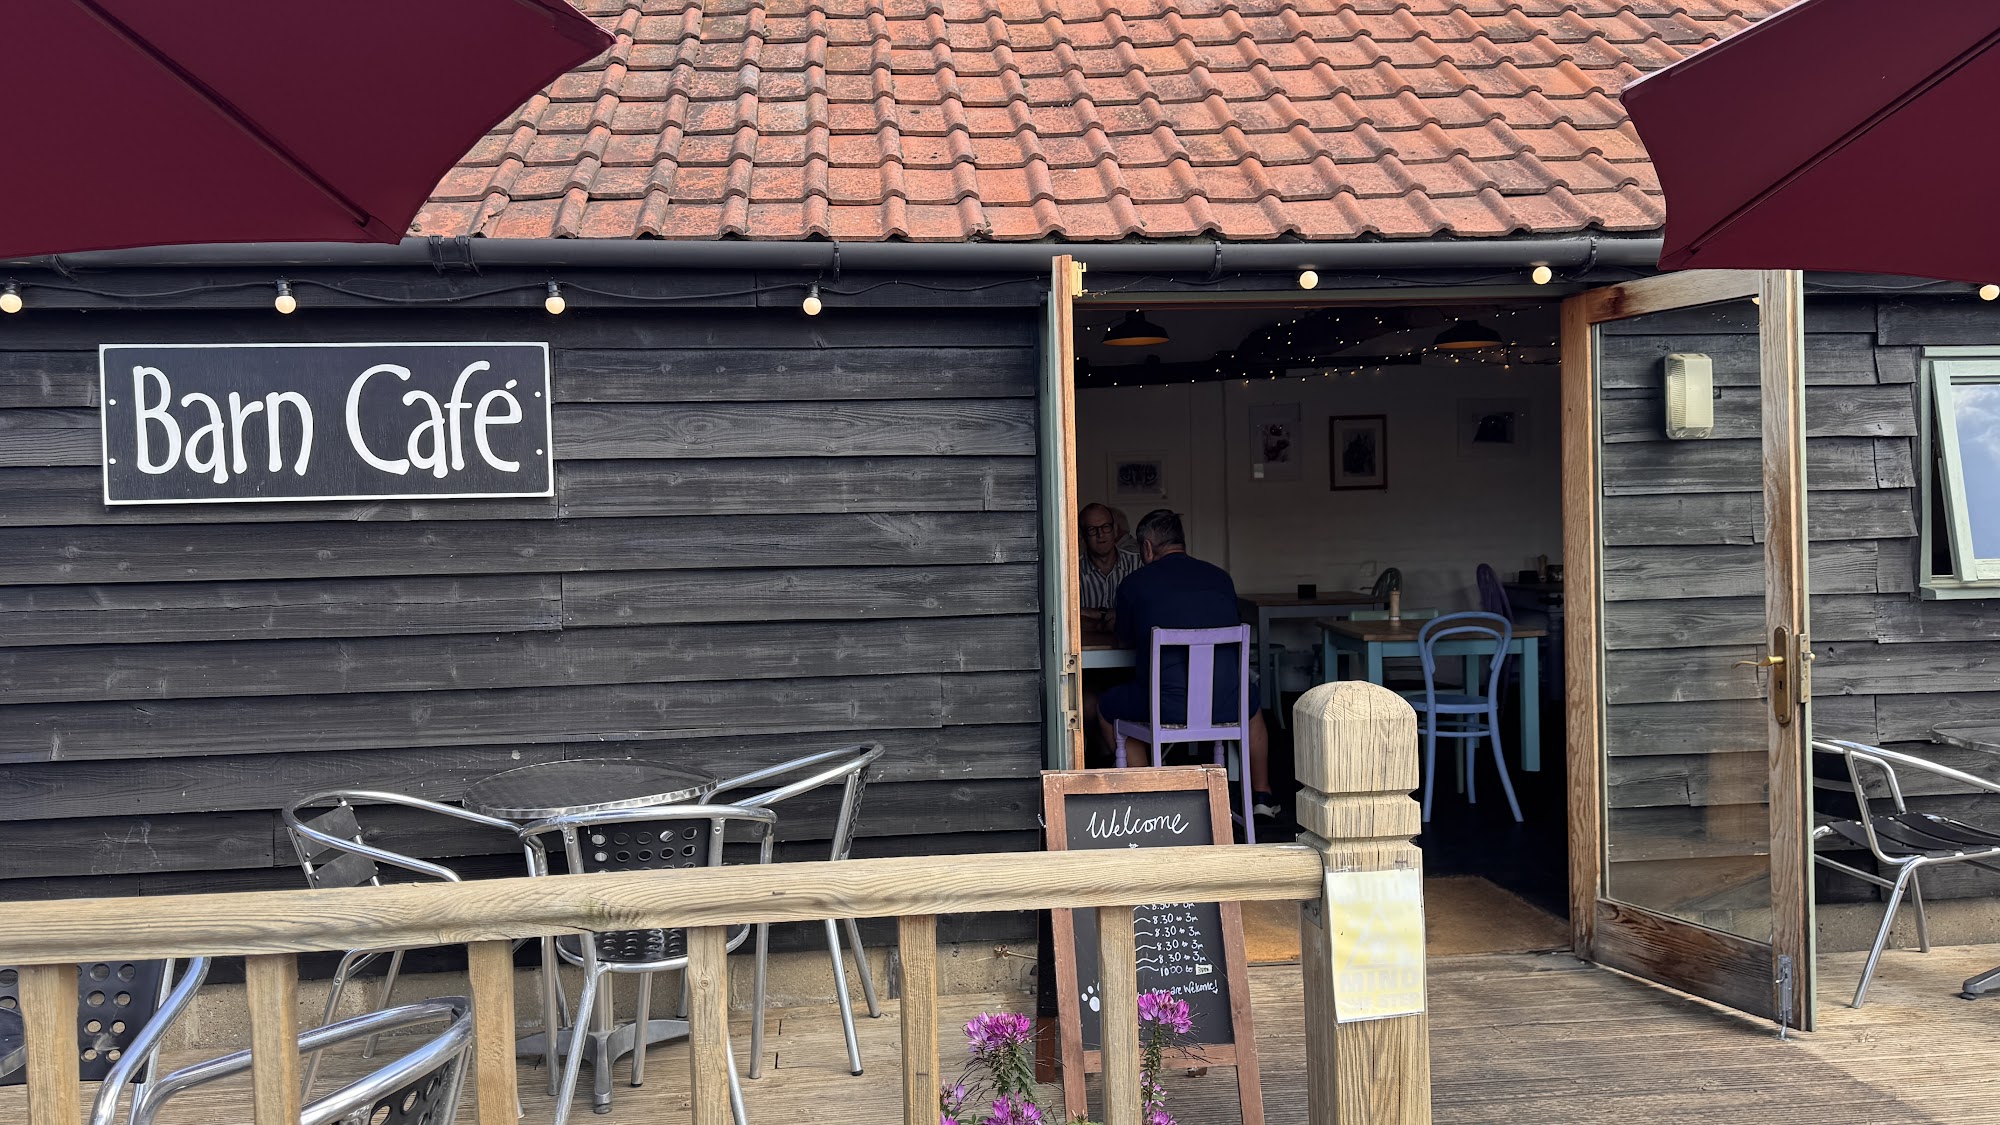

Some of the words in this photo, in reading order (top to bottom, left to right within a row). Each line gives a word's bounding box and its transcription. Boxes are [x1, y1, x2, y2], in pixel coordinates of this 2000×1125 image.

[133, 365, 314, 485] Barn
[345, 360, 523, 479] Café
[1086, 805, 1189, 838] Welcome
[1152, 913, 1174, 924] 8.30
[1155, 925, 1177, 937] 8.30
[1157, 939, 1179, 951] 8.30
[1159, 952, 1181, 964] 8.30
[1186, 965, 1193, 973] to
[1170, 986, 1182, 995] are
